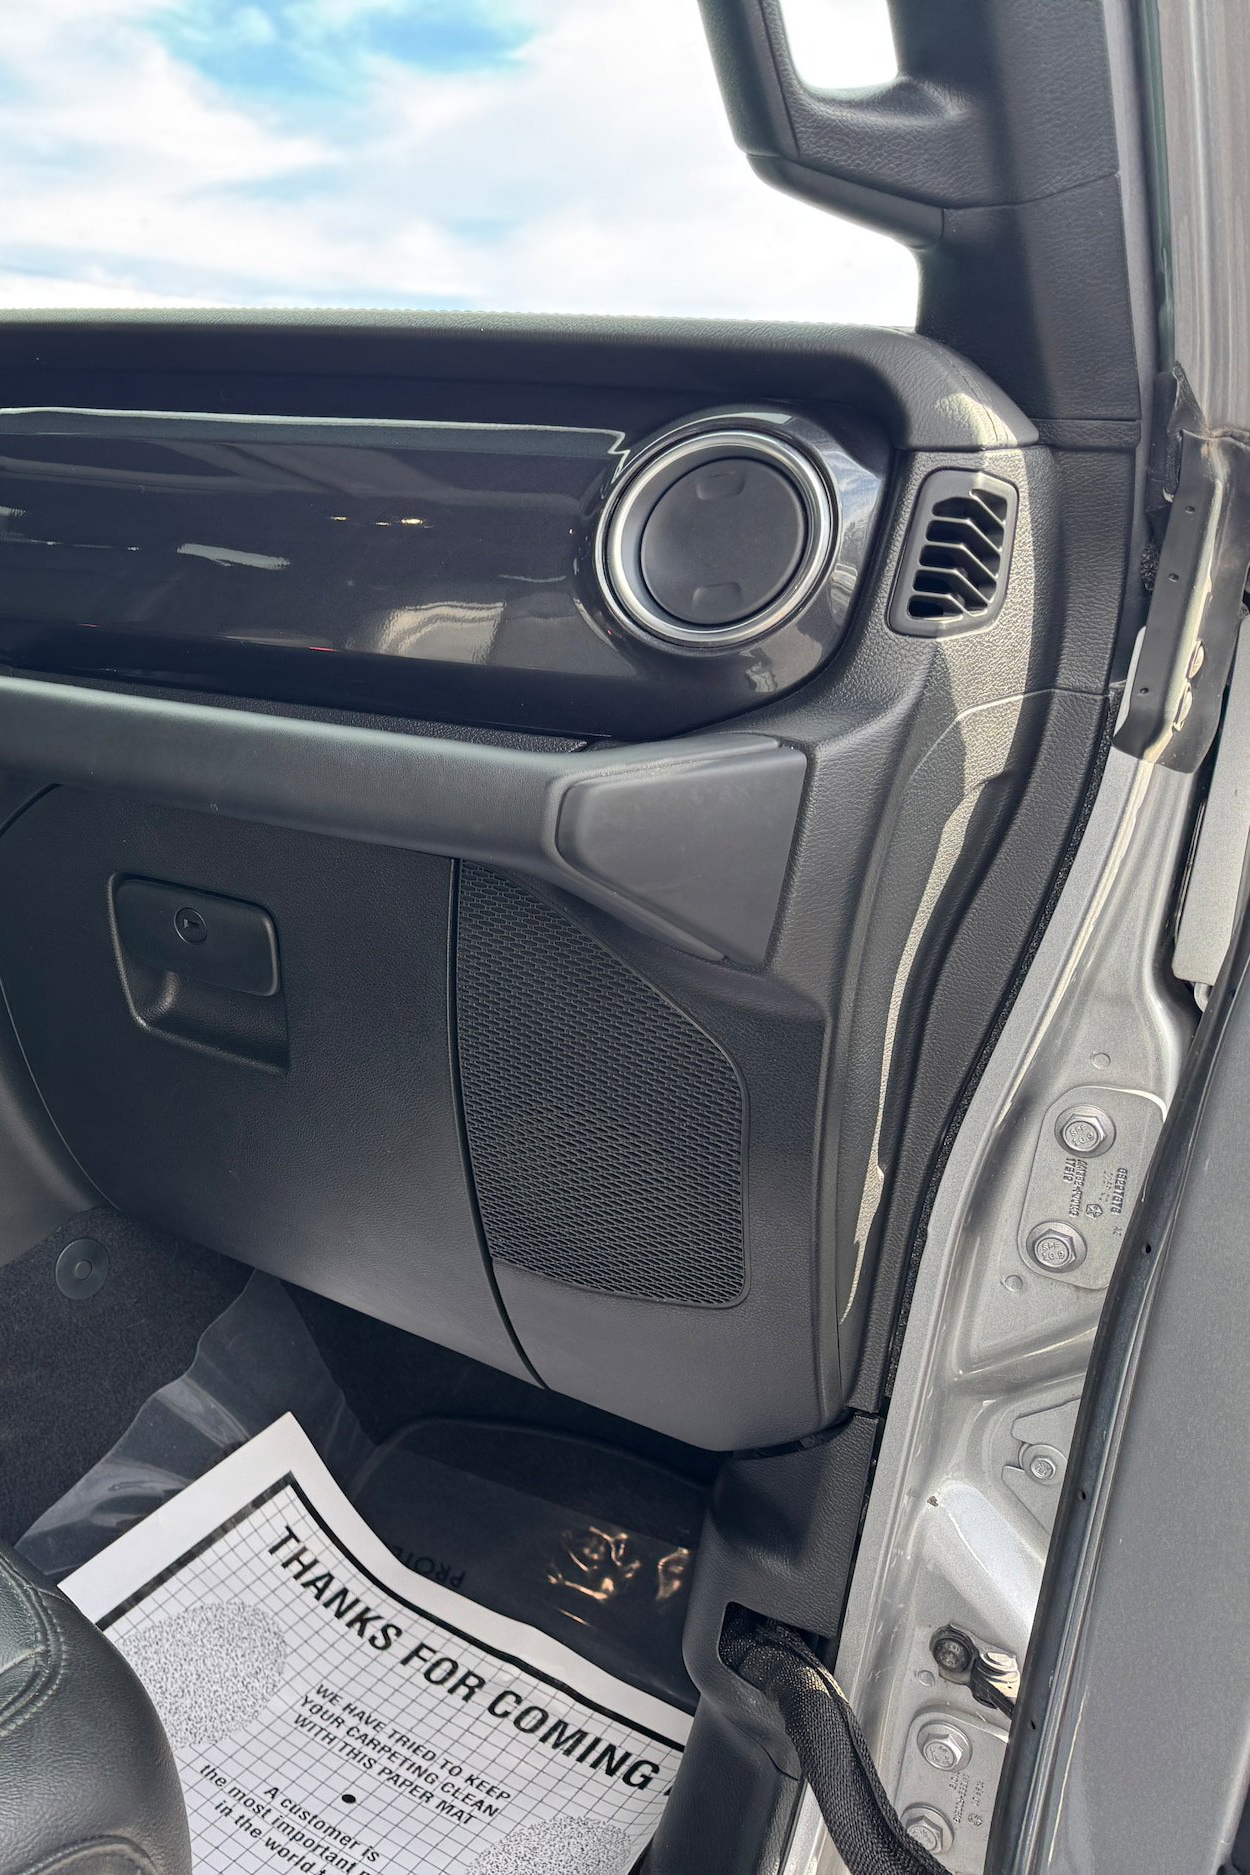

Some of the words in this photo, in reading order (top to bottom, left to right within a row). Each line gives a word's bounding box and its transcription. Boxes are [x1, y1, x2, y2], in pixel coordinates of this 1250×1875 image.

[268, 1525, 403, 1651] THANKS
[401, 1642, 486, 1703] FOR
[487, 1690, 660, 1790] COMING
[294, 1714, 338, 1745] WITH
[338, 1740, 378, 1770] THIS
[377, 1766, 434, 1803] PAPER
[435, 1800, 477, 1825] MAT
[301, 1694, 345, 1728] YOUR
[346, 1726, 439, 1785] CARPETING
[441, 1782, 499, 1817] CLEAN
[316, 1684, 343, 1706] WE
[342, 1703, 387, 1733] HAVE
[388, 1728, 436, 1761] TRIED
[439, 1758, 463, 1777] TO
[464, 1774, 511, 1801] KEEP
[200, 1764, 227, 1787] the
[228, 1786, 272, 1819] most
[271, 1815, 357, 1874] important
[214, 1800, 233, 1818] in
[234, 1814, 262, 1839] the
[264, 1836, 317, 1873] world
[264, 1786, 280, 1800] A
[280, 1798, 360, 1850] customer
[361, 1845, 380, 1863] is
